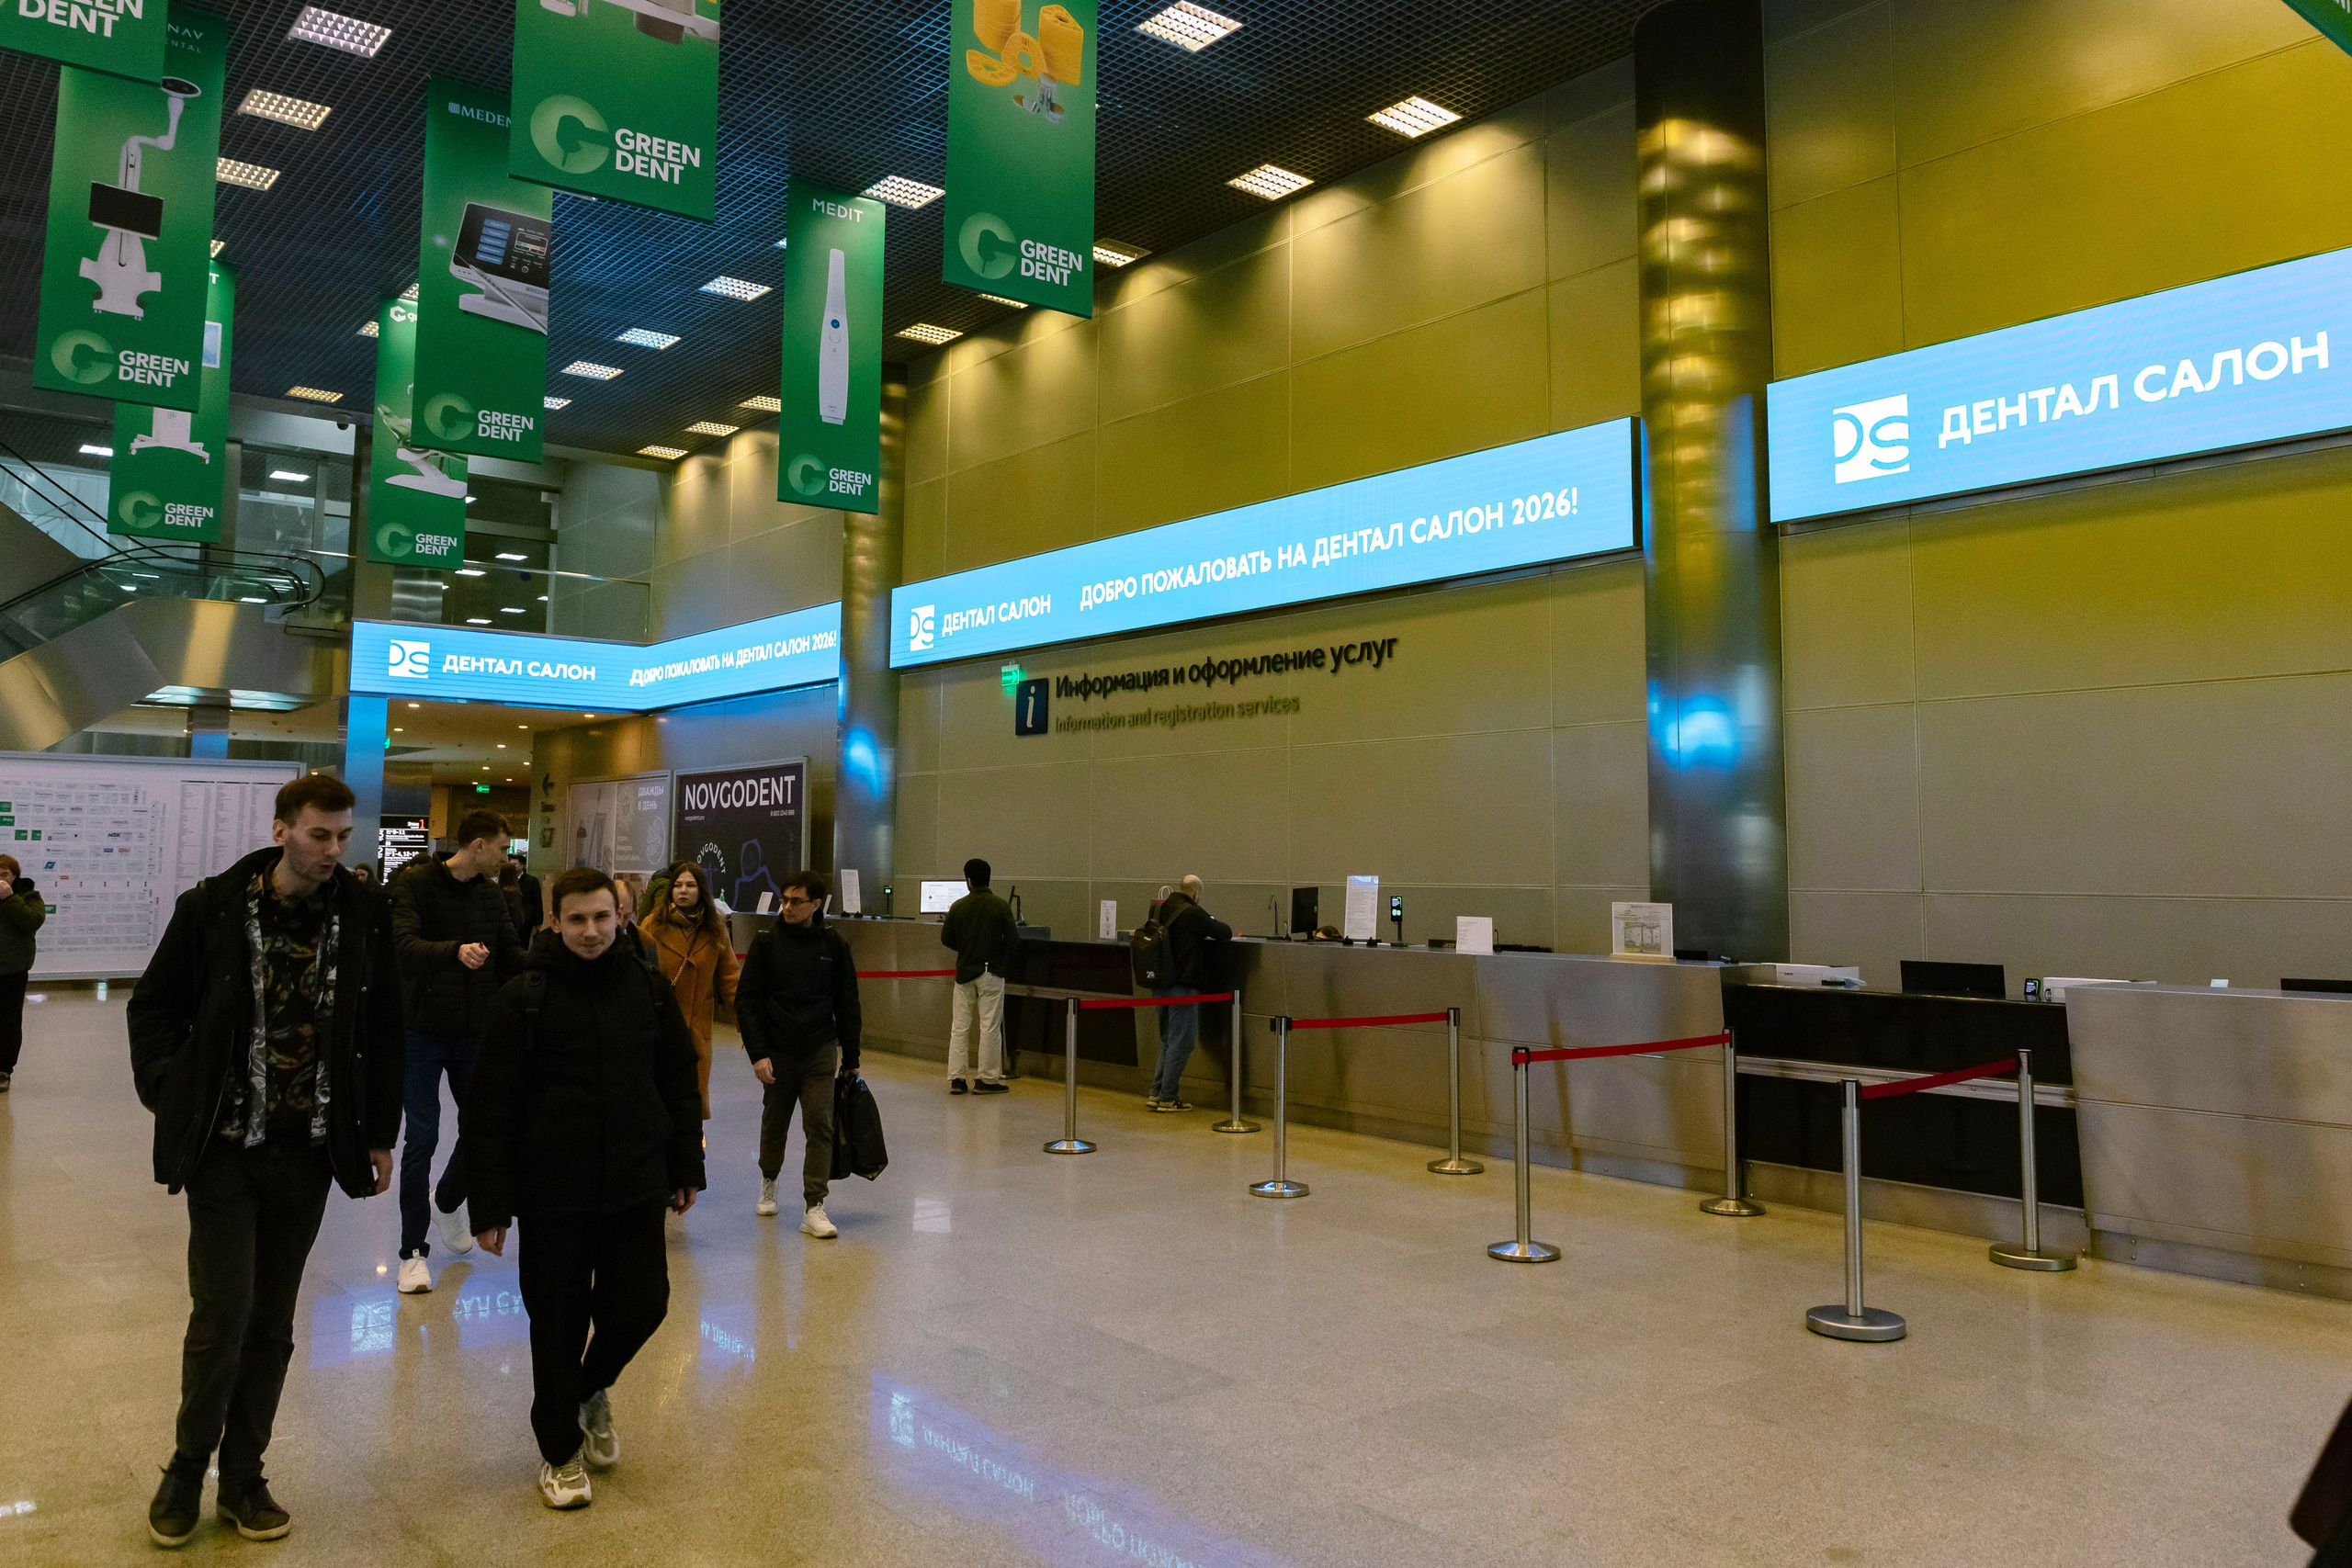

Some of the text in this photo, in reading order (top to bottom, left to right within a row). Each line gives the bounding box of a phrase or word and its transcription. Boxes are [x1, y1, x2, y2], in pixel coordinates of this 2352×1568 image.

[18, 0, 119, 38] DENT
[615, 128, 700, 168] GREEN
[616, 149, 684, 185] DENT
[812, 197, 864, 223] MEDIT
[1020, 238, 1082, 272] GREEN
[1020, 258, 1071, 287] DENT
[119, 350, 189, 376] GREEN
[119, 365, 175, 388] DENT
[1937, 330, 2330, 450] ДЕНТАЛ САЛОН
[478, 409, 534, 431] GREEN
[478, 423, 524, 442] DENT
[829, 467, 872, 486] GREEN
[829, 479, 864, 496] DENT
[164, 502, 214, 518] GREEN
[164, 513, 204, 527] DENT
[415, 533, 458, 547] GREEN
[415, 543, 449, 556] DENT
[1080, 487, 1578, 612] ДОБРО ПОЖАЛОВАТЬ НА ДЕНТАЛ САЛОН 2026!
[941, 593, 1051, 637] ДЕНТАЛ САЛОН
[442, 654, 596, 681] ДЕНТАЛ САЛОН
[629, 630, 837, 687] ДОБРО ПОЖАЛОВАТЬ НА ДЕНТАЛ САЛОН 2026!
[1056, 637, 1397, 702] Информация и оформление услуг
[1056, 694, 1301, 733] Information and registration services
[684, 774, 796, 810] NOVGODENT
[419, 818, 425, 829] 1
